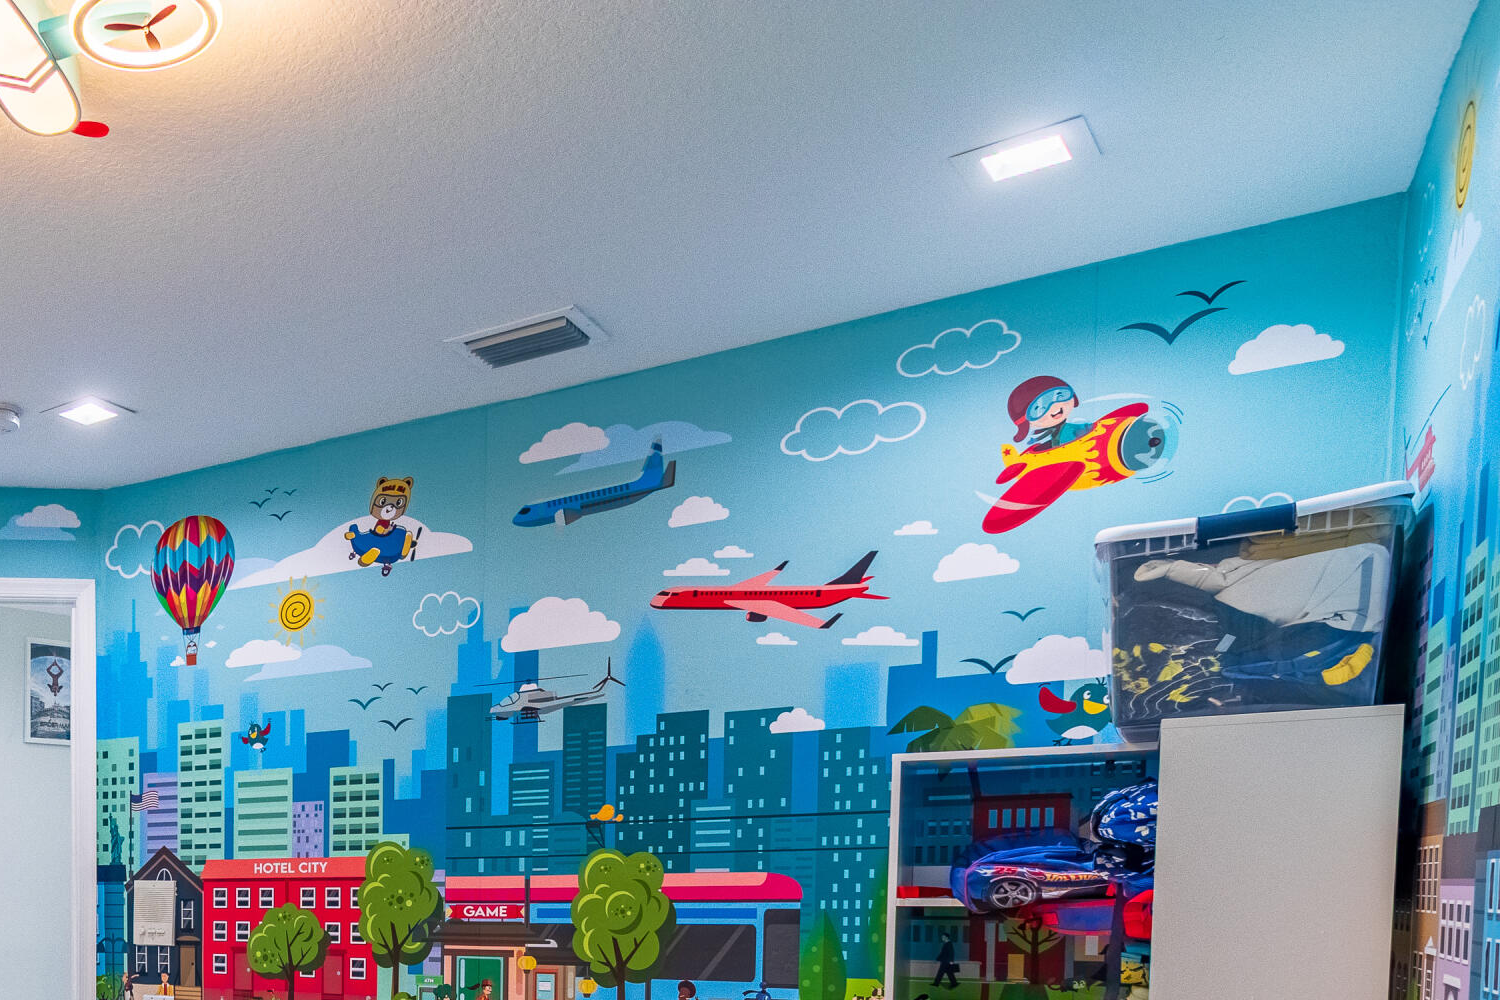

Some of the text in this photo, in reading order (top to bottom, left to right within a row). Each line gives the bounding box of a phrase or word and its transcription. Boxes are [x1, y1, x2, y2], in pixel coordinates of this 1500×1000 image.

[253, 861, 328, 874] HOTEL CITY
[463, 906, 508, 917] GAME
